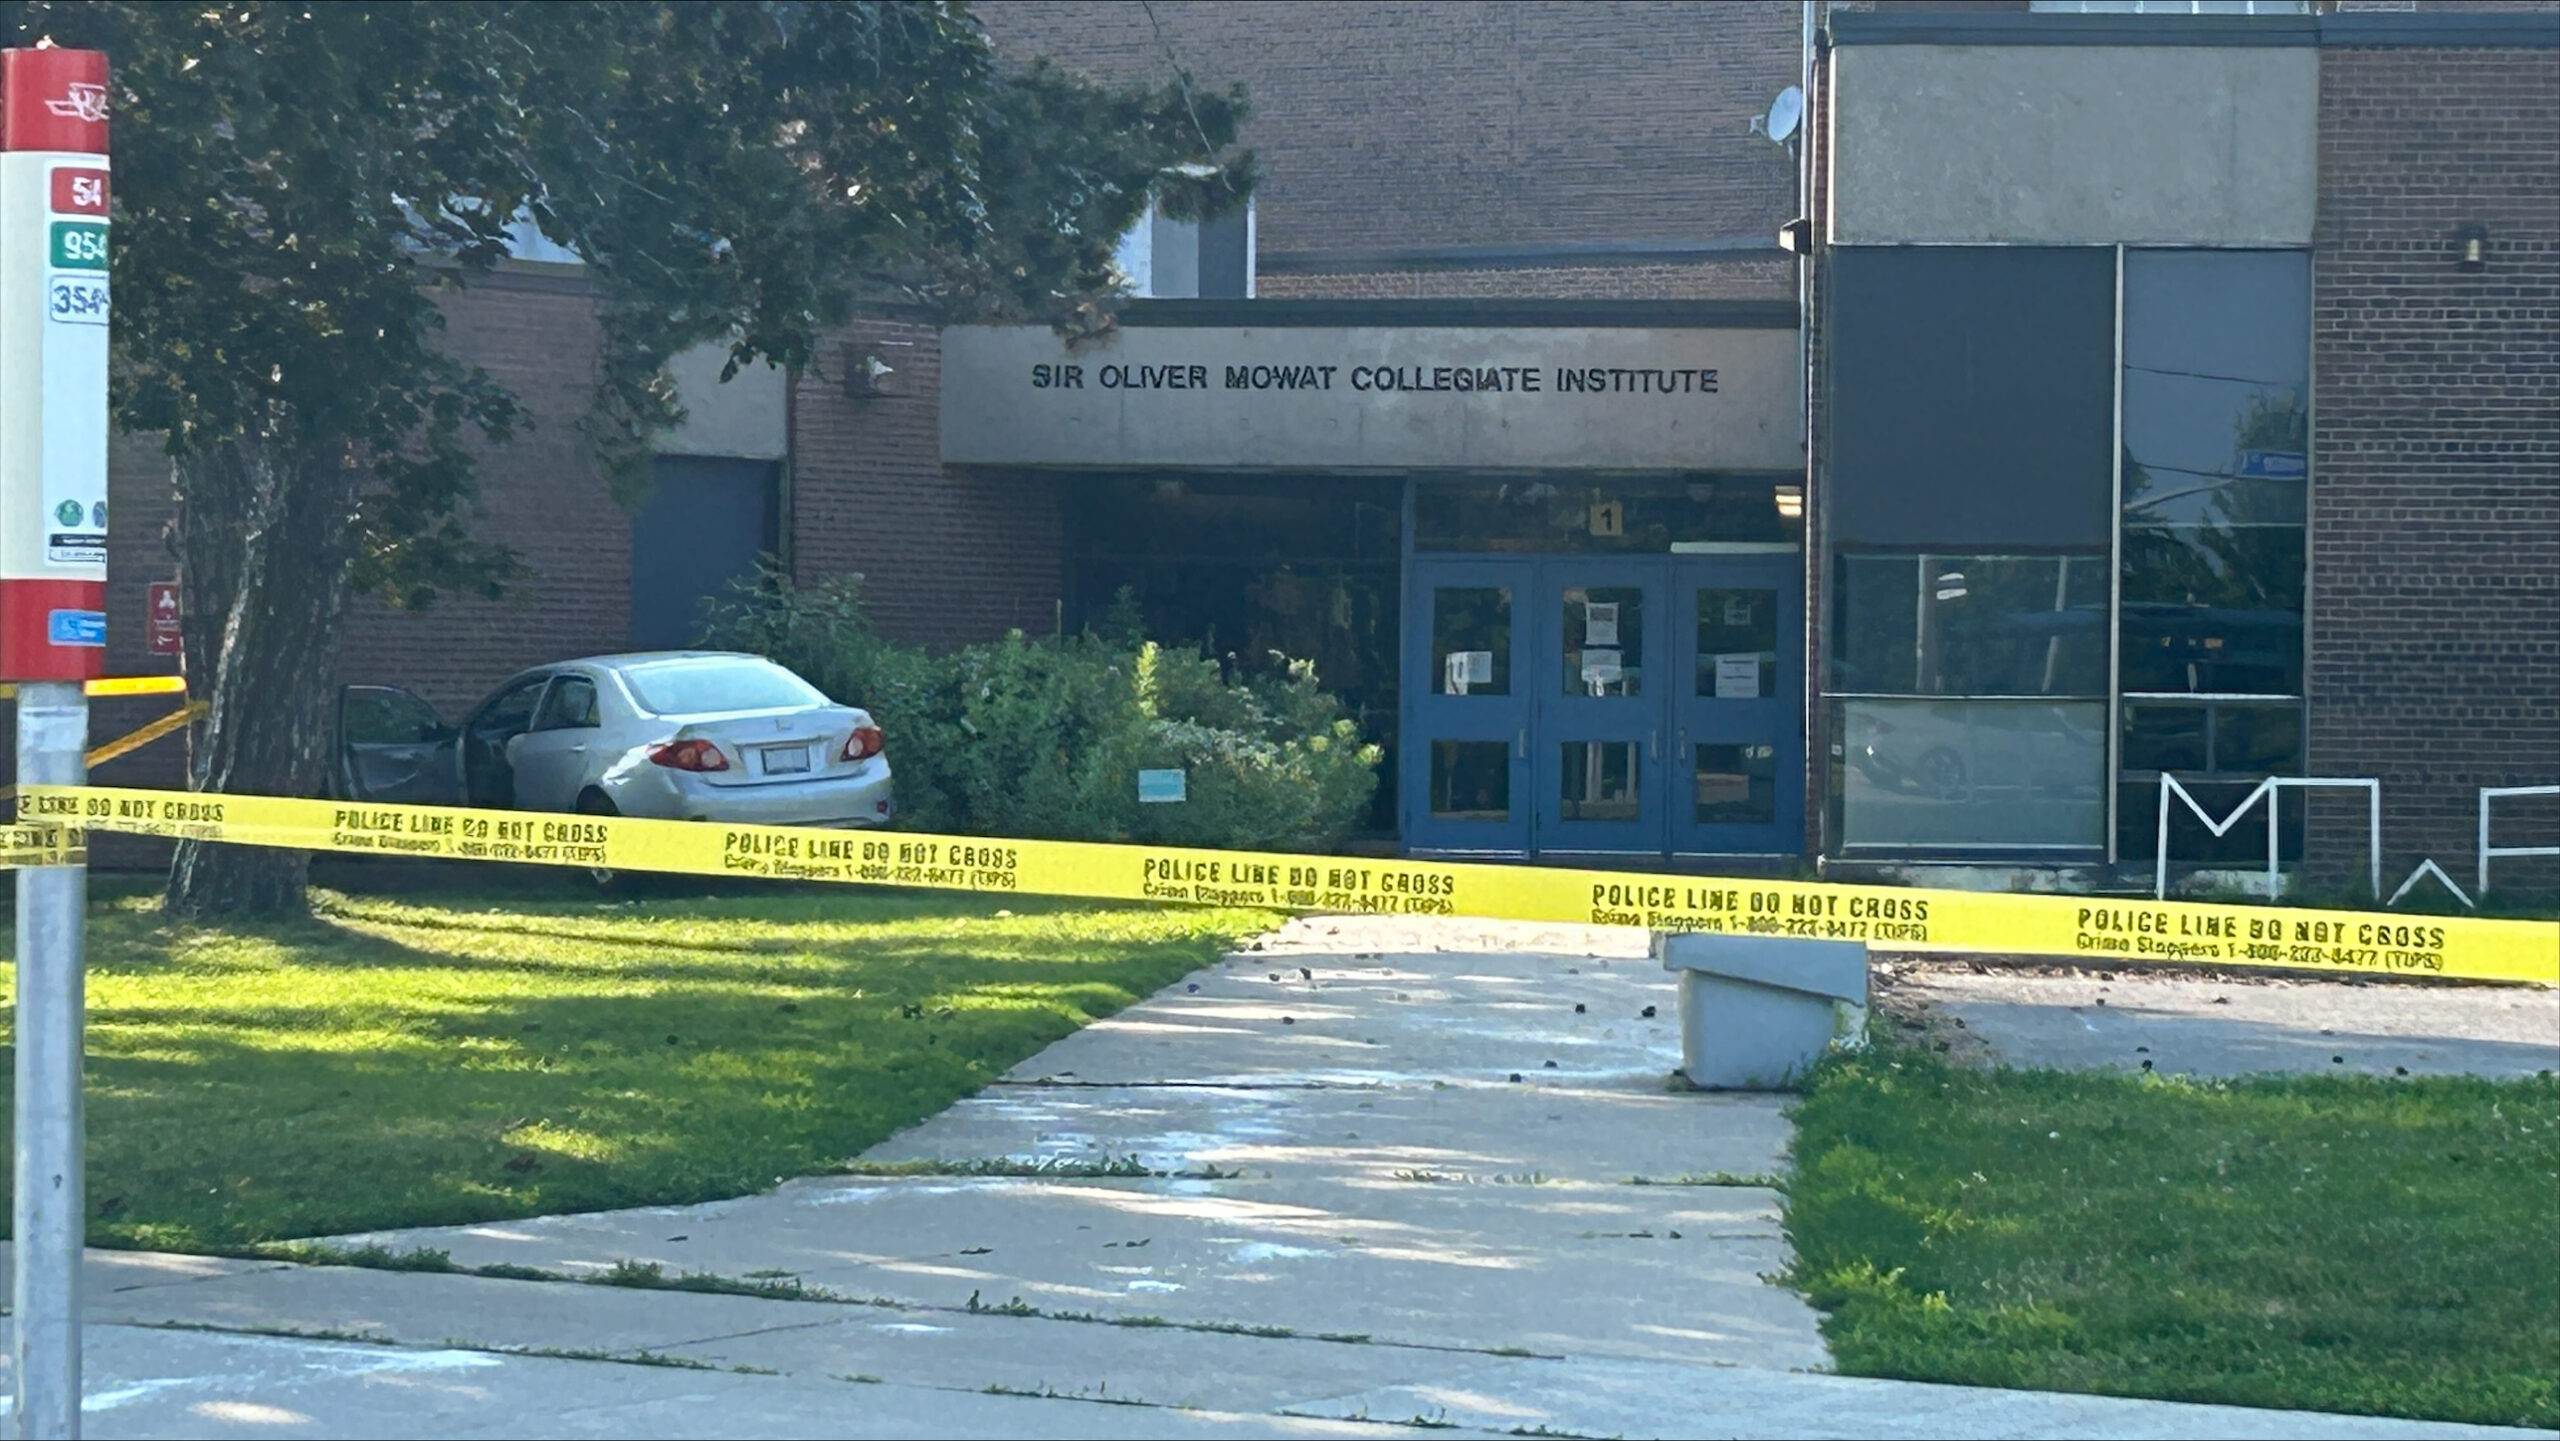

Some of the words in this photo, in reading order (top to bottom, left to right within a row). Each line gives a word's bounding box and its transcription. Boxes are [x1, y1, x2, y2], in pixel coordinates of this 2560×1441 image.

[1032, 364, 1084, 388] SIR
[1099, 365, 1208, 389] OLIVER
[1225, 366, 1337, 390] MOWAT
[1351, 366, 1540, 391] COLLEGIATE
[1556, 368, 1719, 393] INSTITUTE
[1601, 508, 1612, 531] 1
[335, 810, 402, 833] POLICE
[411, 814, 453, 836] LINE
[463, 817, 488, 838] DO
[498, 819, 534, 840] NOT
[543, 821, 607, 844] CROSS
[725, 832, 798, 857] POLICE
[809, 837, 853, 860] LINE
[863, 840, 889, 862] DO
[900, 842, 938, 865] NOT
[949, 845, 1016, 869] CROSS
[1144, 858, 1220, 882] POLICE
[1232, 863, 1279, 886] LINE
[1289, 866, 1317, 888] DO
[1328, 868, 1371, 891] NOT
[1382, 871, 1454, 895] CROSS
[1592, 883, 1676, 908] POLICE
[1687, 888, 1738, 912] LINE
[1750, 892, 1780, 914] DO
[1793, 894, 1838, 917] NOT
[1850, 897, 1929, 922] CROSS
[2078, 908, 2168, 935] POLICE
[2181, 914, 2236, 938] LINE
[2250, 917, 2282, 941] DO
[2296, 920, 2345, 944] NOT
[2359, 923, 2444, 950] CROSS
